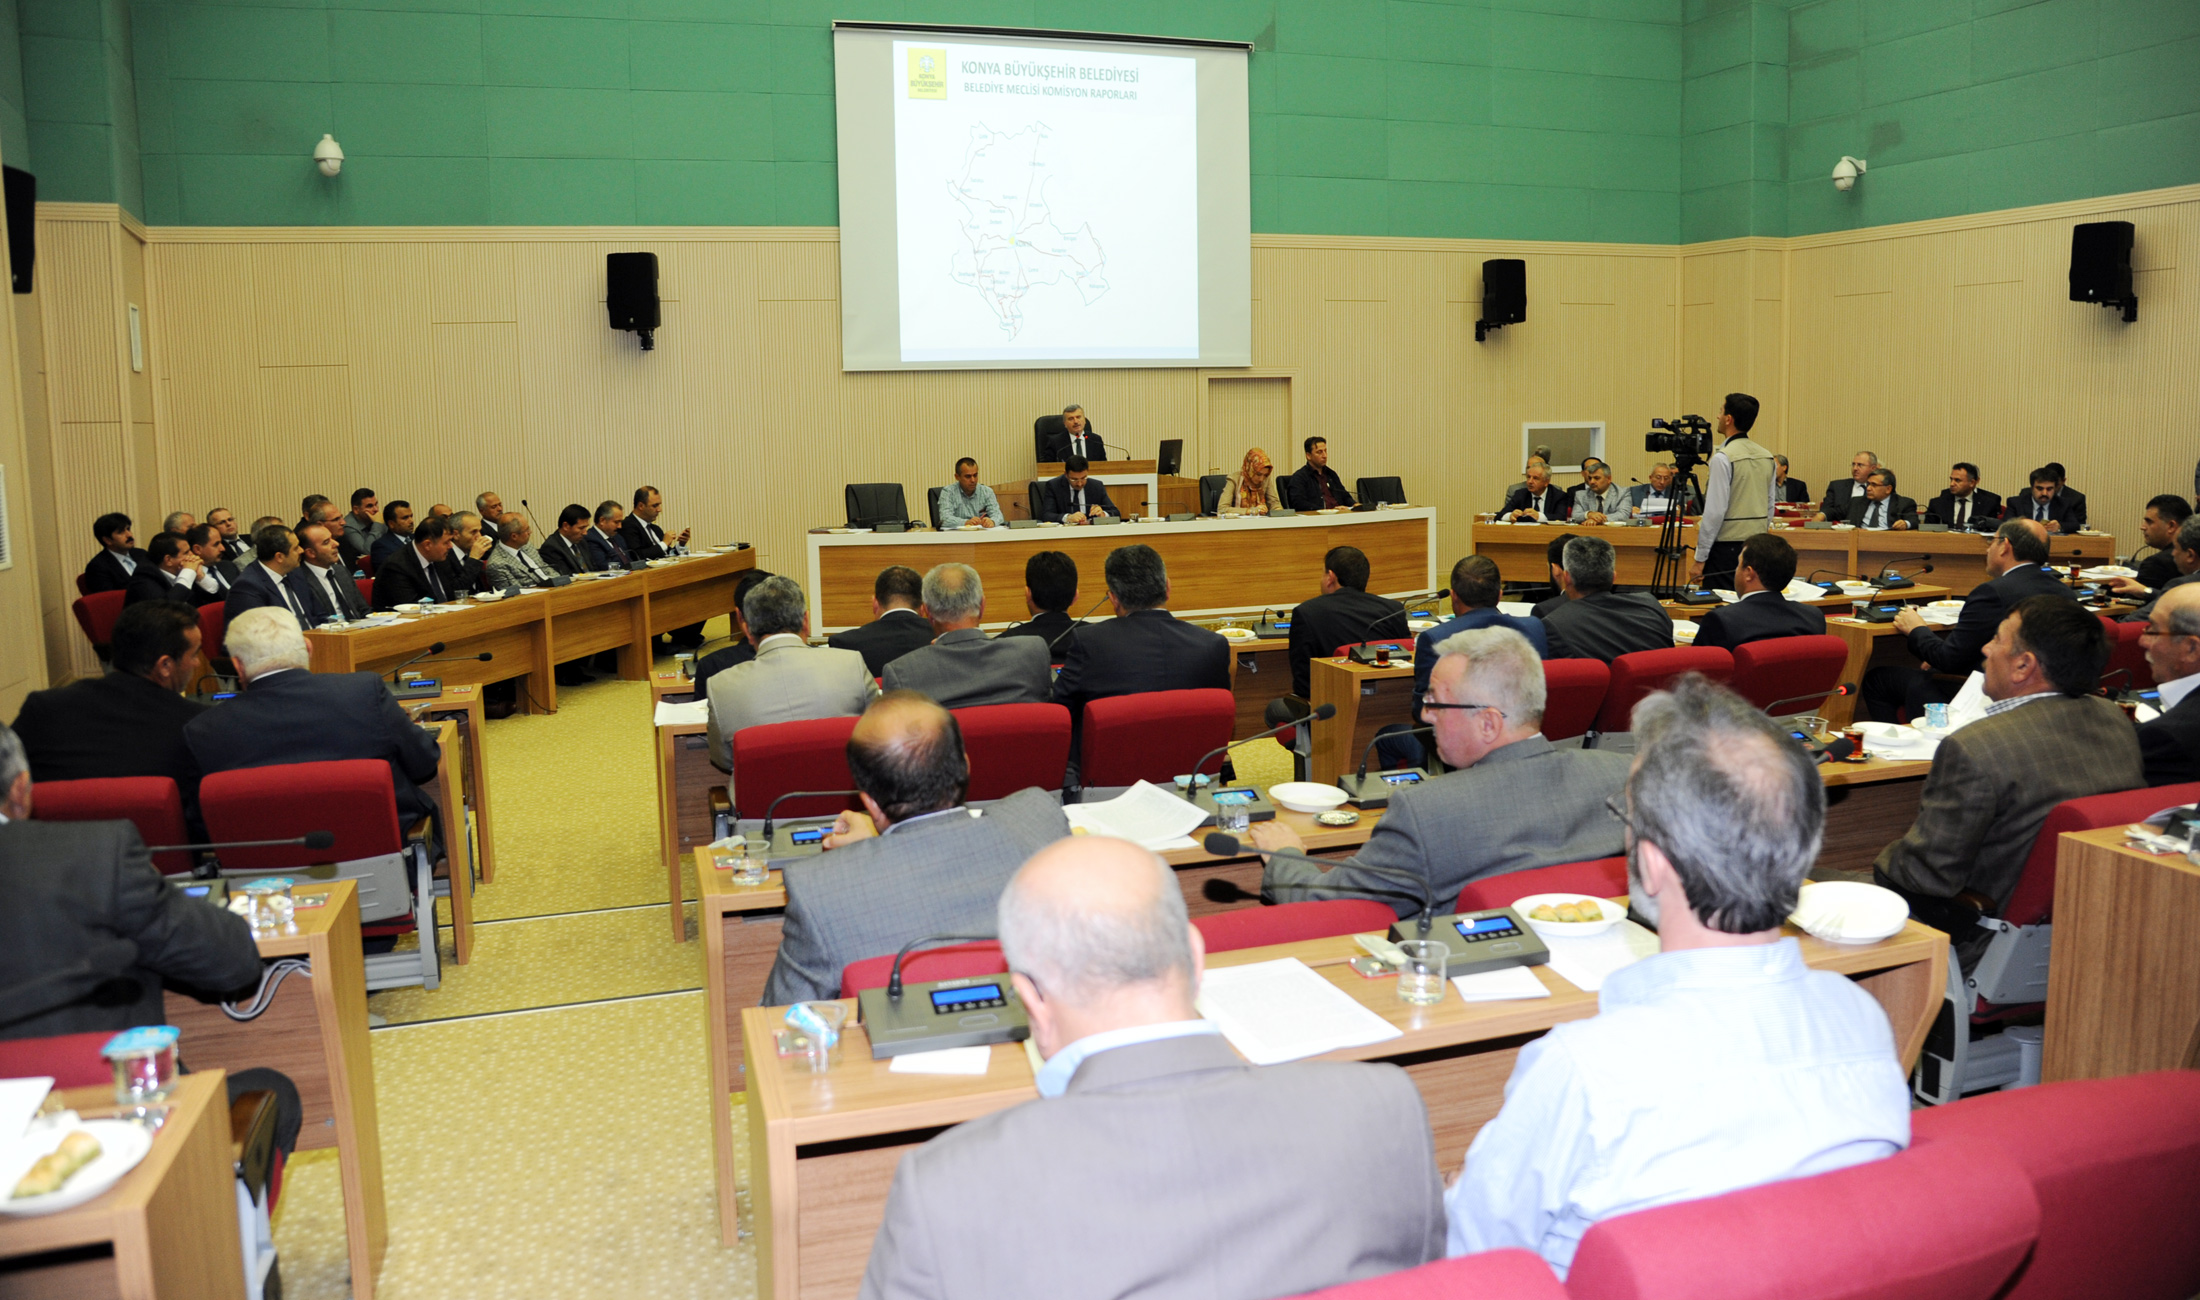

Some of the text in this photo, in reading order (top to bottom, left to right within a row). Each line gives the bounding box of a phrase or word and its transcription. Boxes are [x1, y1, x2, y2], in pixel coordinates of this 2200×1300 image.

[961, 60, 1139, 83] KONYA BÜYÜKŞEHİR BELEDİYESİ
[964, 80, 1137, 101] BELEDİYE MECLİSİ KOMİSYON RAPORLARI
